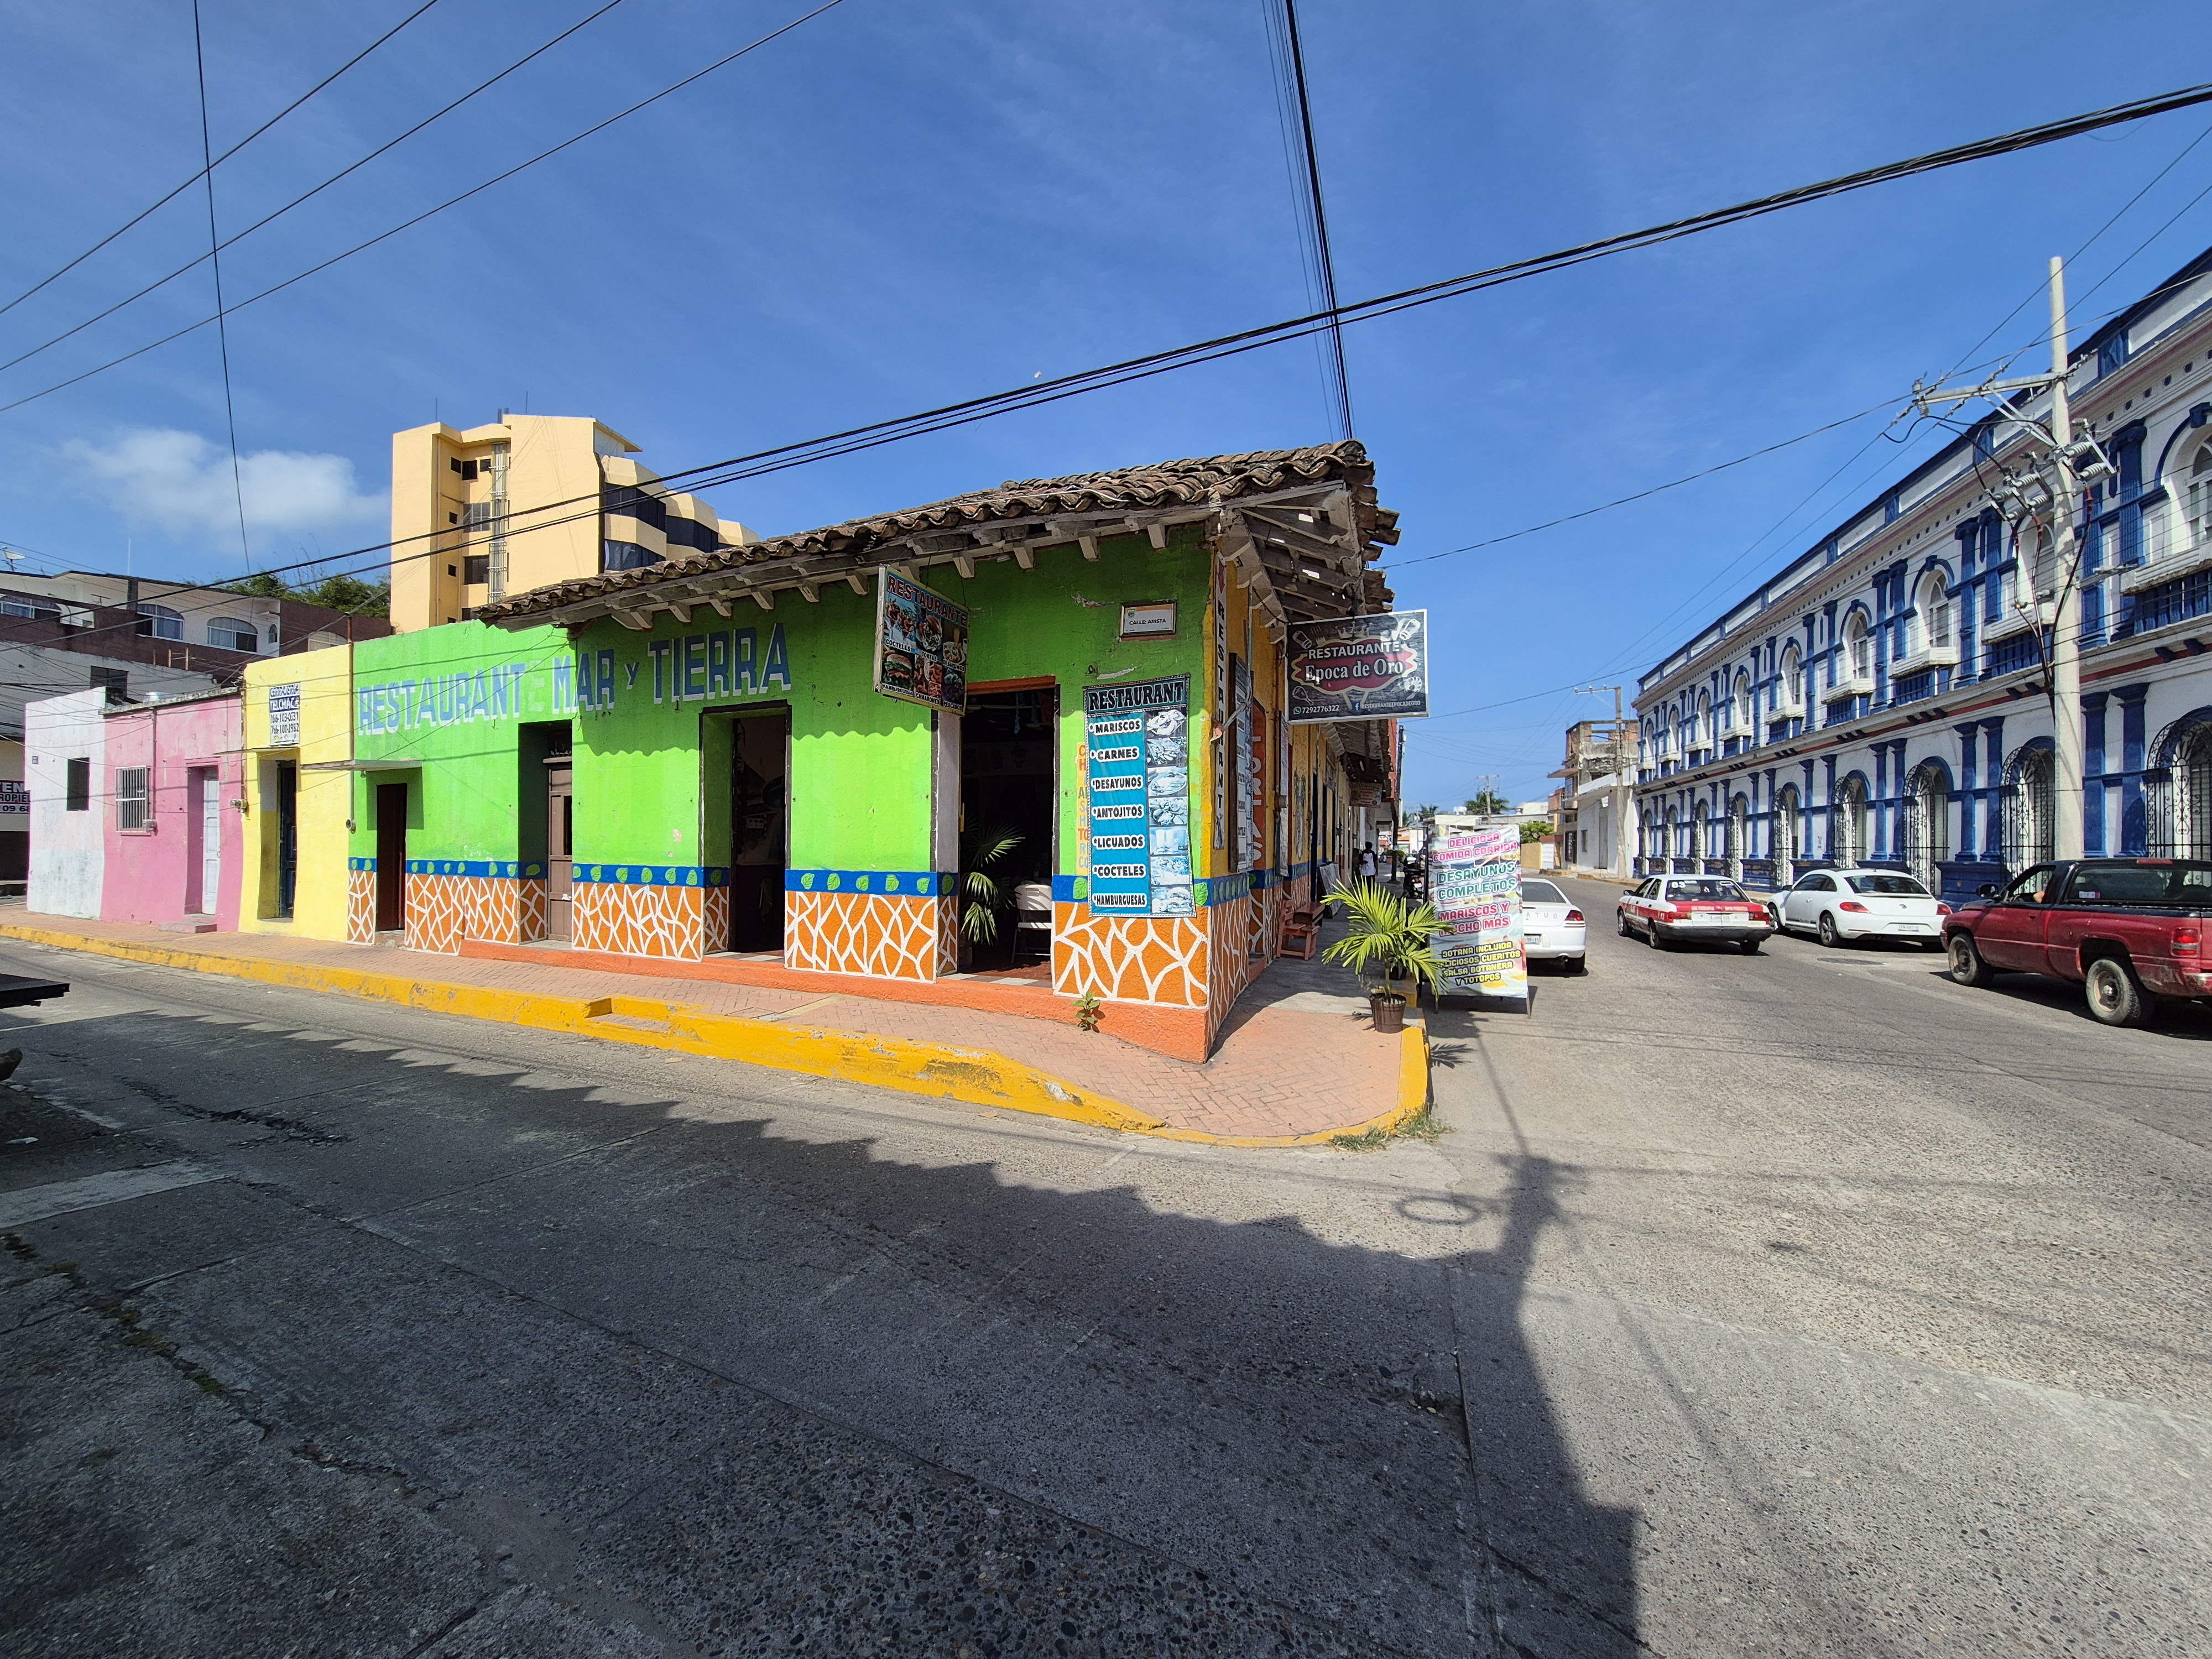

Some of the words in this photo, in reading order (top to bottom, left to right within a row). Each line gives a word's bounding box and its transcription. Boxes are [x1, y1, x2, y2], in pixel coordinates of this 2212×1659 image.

[888, 575, 967, 628] RESTAURANTE
[886, 639, 911, 651] COCTELES
[1308, 641, 1400, 659] RESTAURANTE
[922, 651, 937, 661] TORTAS
[552, 649, 615, 714] MAR
[648, 623, 791, 705] TIERRA
[943, 660, 965, 671] DESAYUNOS
[1305, 665, 1348, 685] Epoca
[1353, 661, 1370, 677] de
[1374, 659, 1403, 675] Oro
[916, 693, 940, 705] CAMARONES
[1089, 682, 1183, 711] RESTAURANT
[1302, 705, 1339, 713] 7292776322
[1095, 721, 1140, 733] MARISCOS
[1098, 748, 1138, 760] CARNES
[1095, 777, 1141, 790] DESAYUNOS
[1096, 806, 1142, 818] ANTOJITOS
[1097, 837, 1143, 848] LICUADOS
[1449, 833, 1500, 848] DELICIOSA
[1433, 850, 1470, 862] COMIDA
[1474, 842, 1517, 855] CORRIDA
[1097, 866, 1144, 877] COCTELES
[1439, 863, 1515, 884] DESAYUNOS
[1438, 879, 1516, 900] COMPLETOS
[1097, 895, 1145, 905] HAMBURGUESAS
[1440, 905, 1498, 921] MARISCOS
[1501, 902, 1509, 912] Y
[1484, 916, 1509, 929] MÁS
[1476, 942, 1512, 953] INCLUIDA
[1481, 951, 1521, 962] CUERITOS
[1443, 968, 1468, 977] SALSA
[1471, 962, 1512, 973] BOTANERA
[1464, 973, 1500, 984] TOTOPOS
